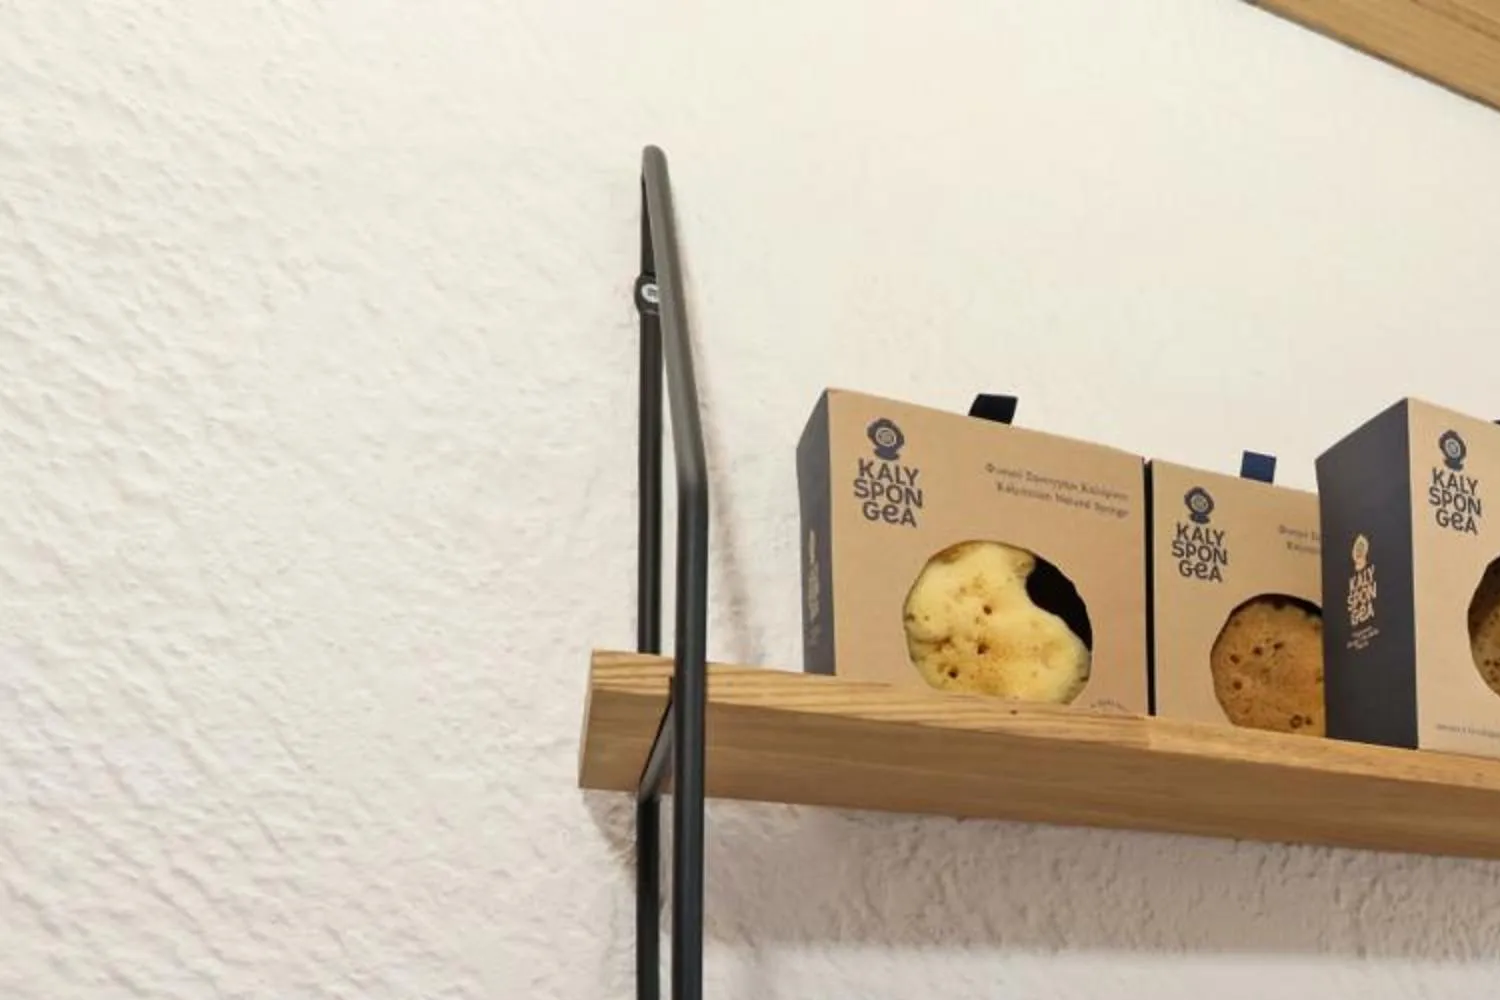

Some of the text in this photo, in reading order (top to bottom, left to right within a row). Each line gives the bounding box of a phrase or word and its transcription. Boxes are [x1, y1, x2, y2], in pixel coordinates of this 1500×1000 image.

[858, 456, 920, 487] KALY
[1432, 467, 1479, 496] KALY
[853, 478, 923, 509] SPON
[1428, 486, 1482, 518] SPON
[1176, 521, 1225, 547] KALY
[1171, 540, 1229, 566] SPON
